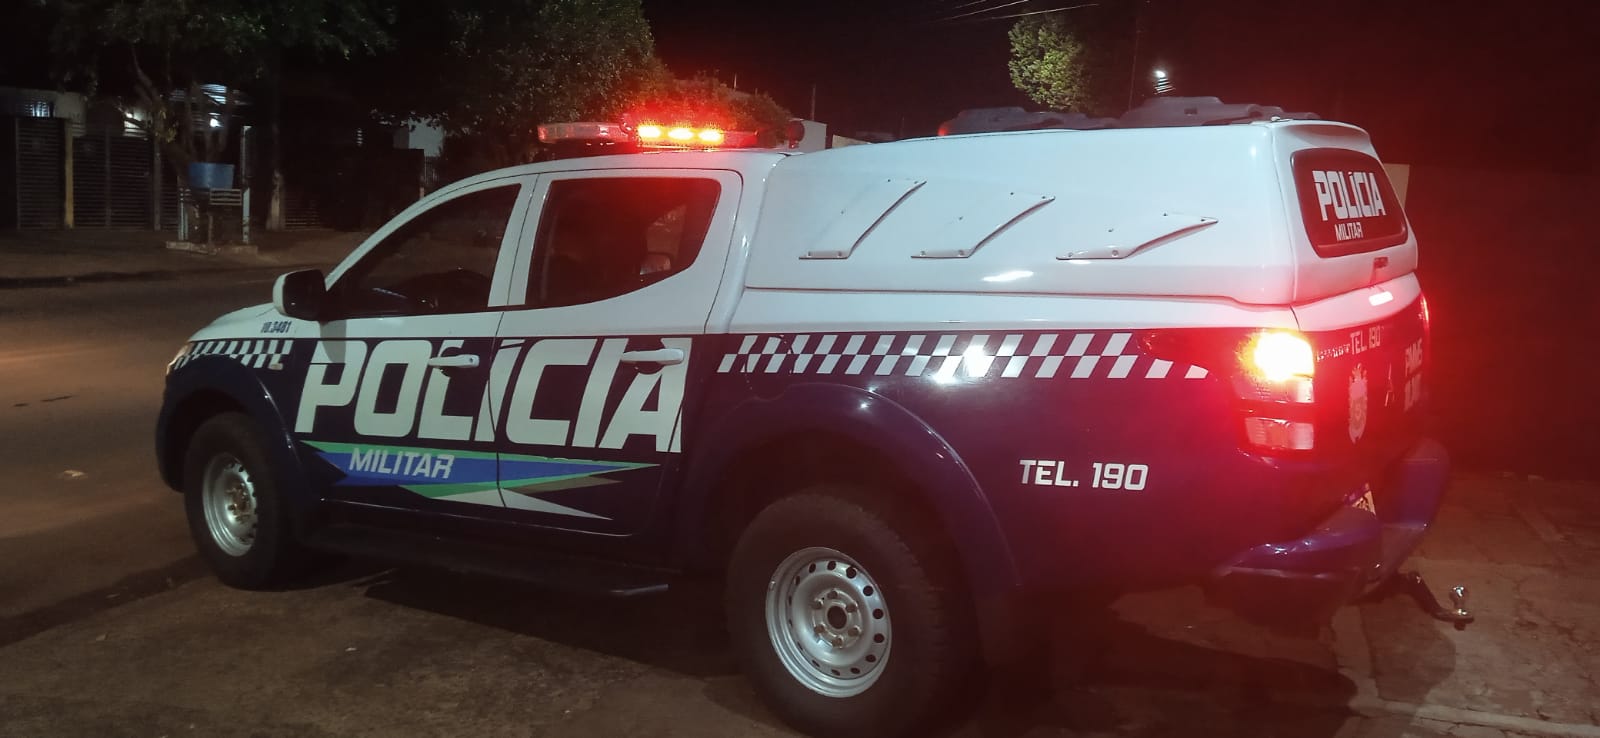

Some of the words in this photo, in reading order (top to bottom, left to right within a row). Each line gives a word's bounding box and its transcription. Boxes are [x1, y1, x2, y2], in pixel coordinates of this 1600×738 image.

[1312, 170, 1387, 222] POLÍCIA
[1334, 222, 1364, 241] MILITAR
[294, 337, 693, 453] POLÍCIA
[348, 447, 455, 479] MILITAR
[1019, 459, 1079, 487] TEL.
[1092, 462, 1149, 491] 190
